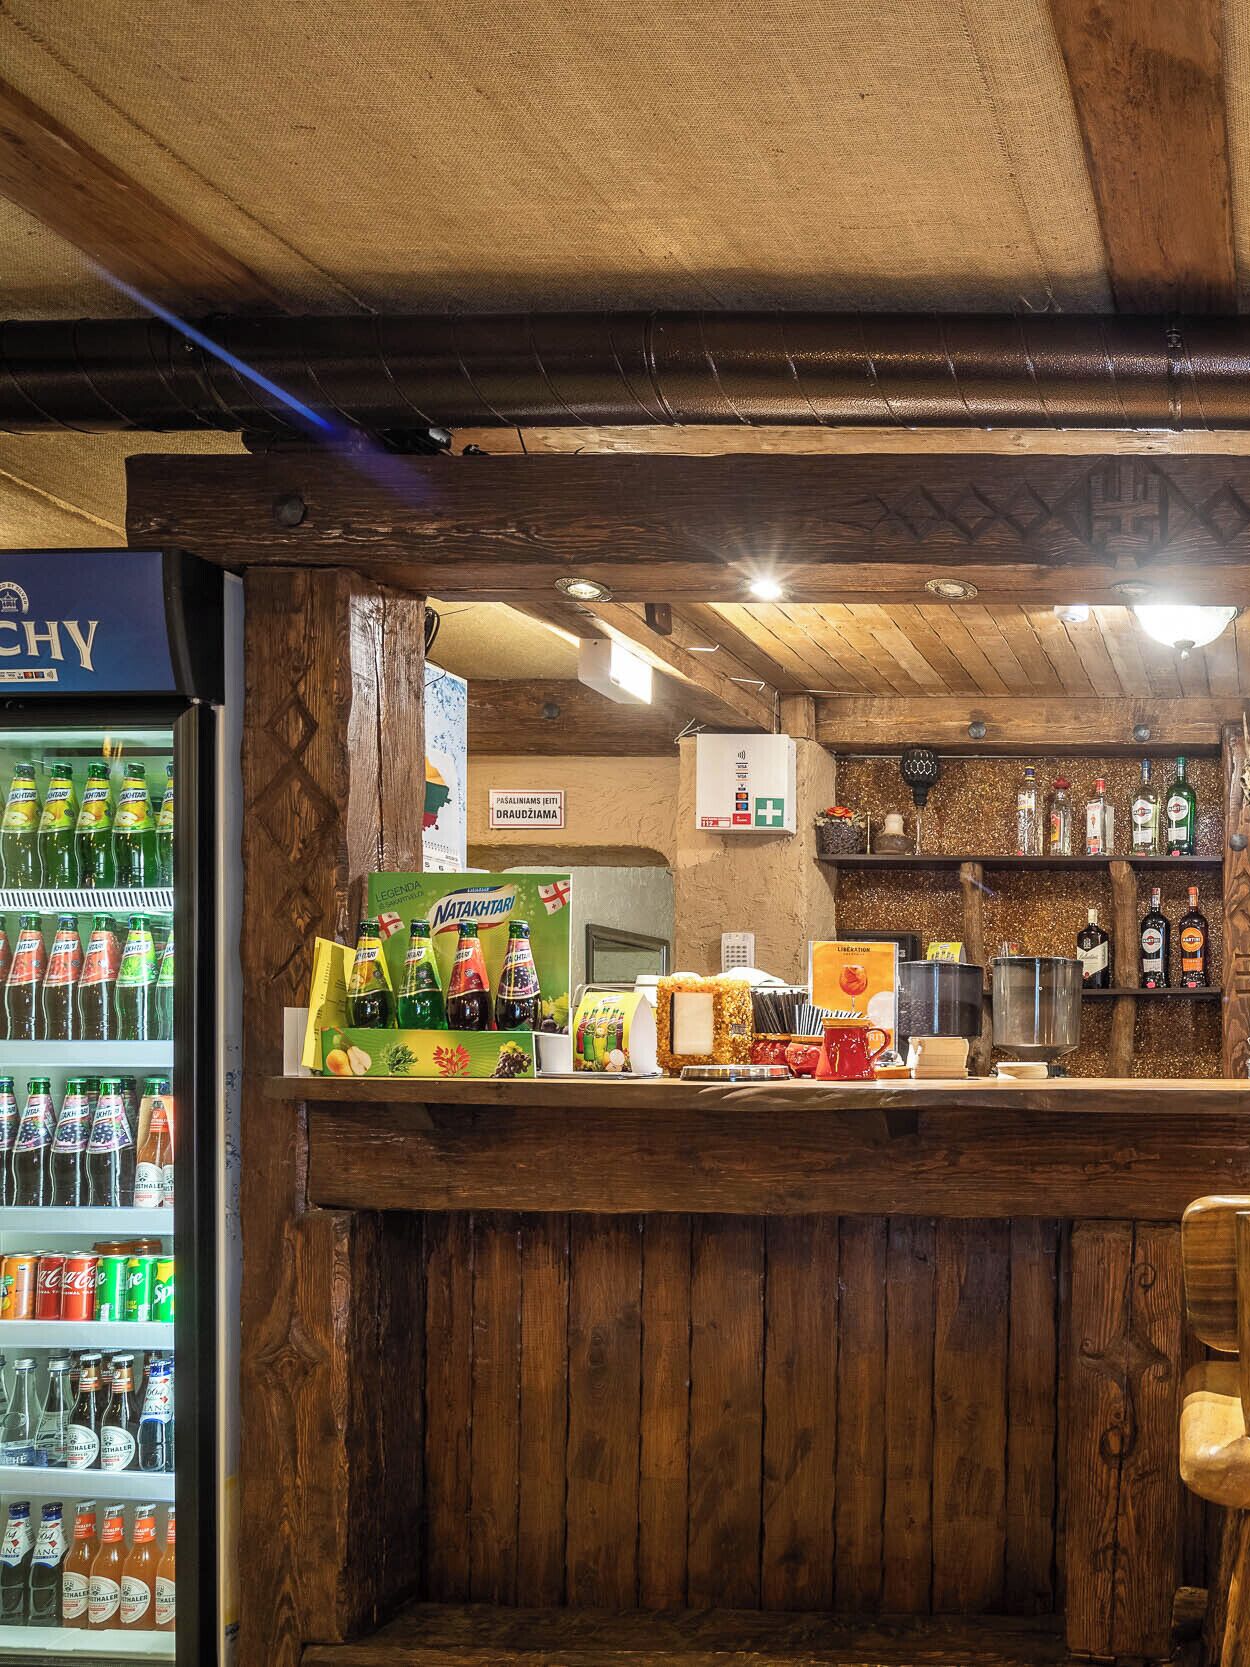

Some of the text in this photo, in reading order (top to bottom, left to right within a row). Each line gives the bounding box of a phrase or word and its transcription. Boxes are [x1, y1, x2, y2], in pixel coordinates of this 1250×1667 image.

[0, 620, 98, 672] CHY
[496, 796, 558, 806] PAŠALINIAMS ĮEITI
[496, 807, 558, 819] DRAUDŽIAMA
[375, 880, 423, 902] LEGENDA
[431, 895, 516, 930] NATAKHTARI
[869, 1033, 885, 1041] RIT
